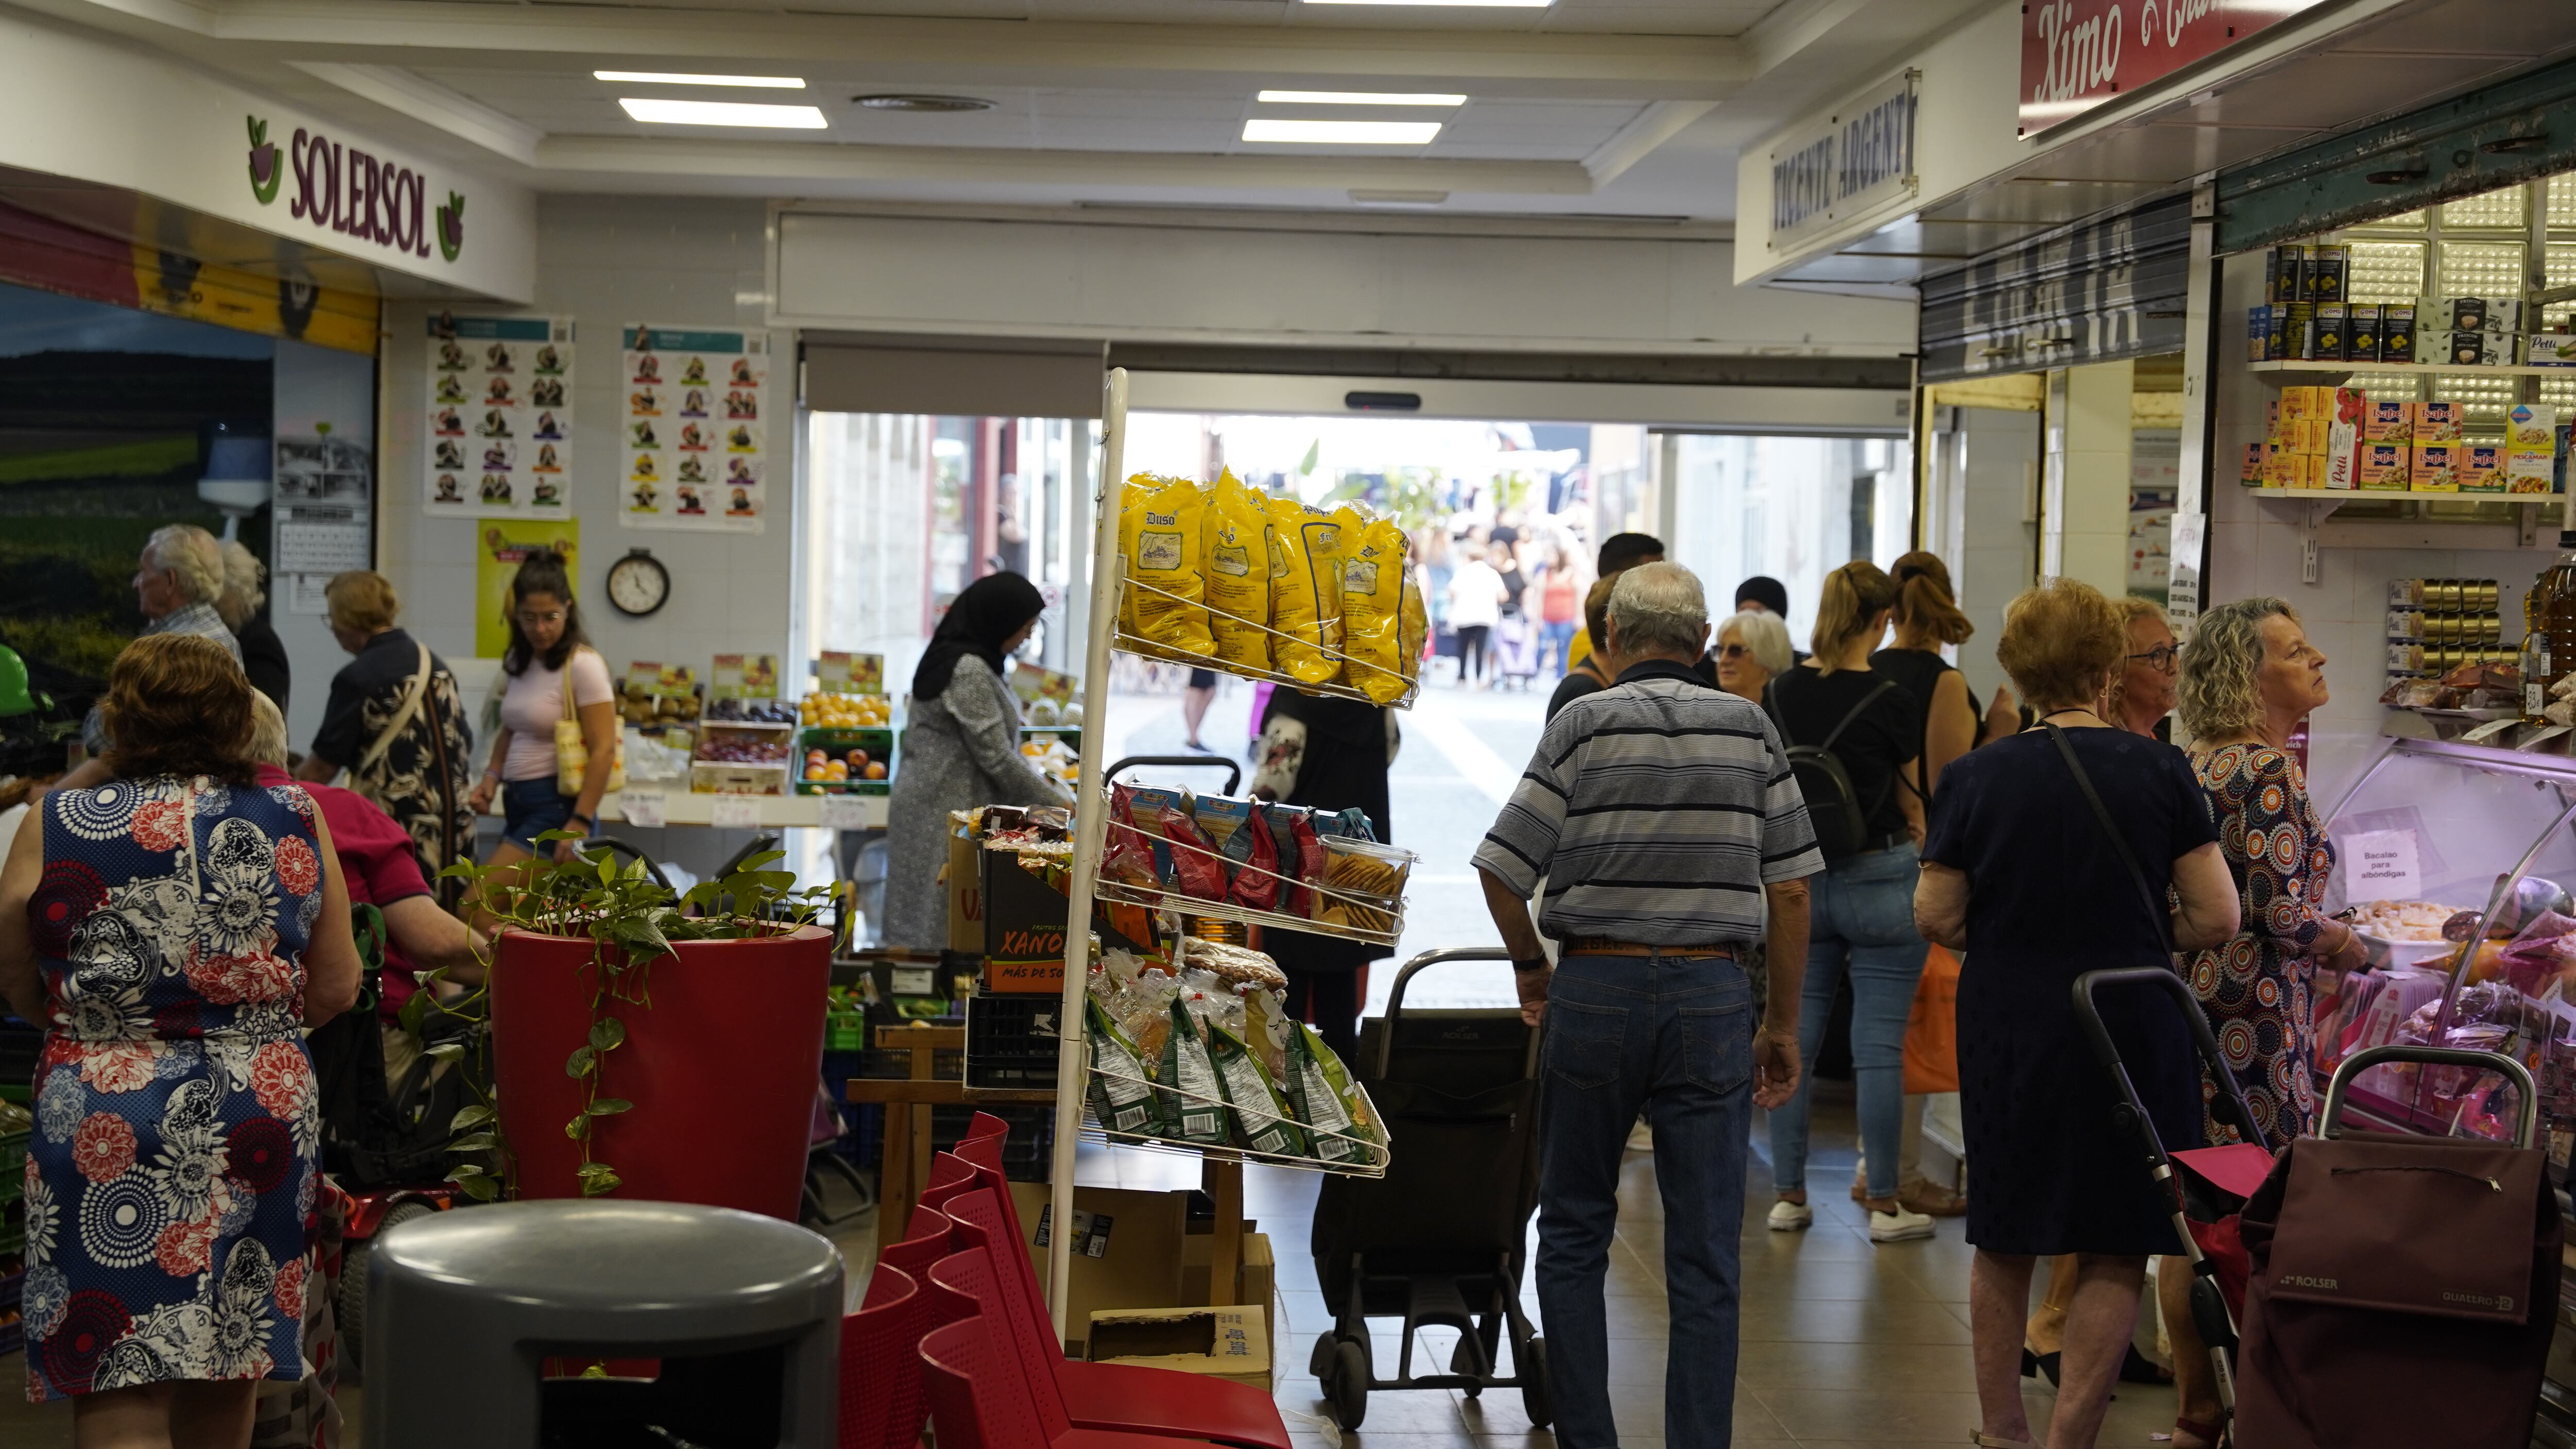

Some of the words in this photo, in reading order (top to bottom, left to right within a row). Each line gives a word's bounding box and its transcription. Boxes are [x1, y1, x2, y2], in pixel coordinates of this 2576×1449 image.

[2035, 0, 2121, 103] Ximo
[1774, 135, 1832, 231] VICENTE
[292, 128, 431, 258] SOLERSOL
[2372, 408, 2406, 420] Isabel
[2421, 409, 2455, 421] Isabel
[2368, 452, 2401, 464] Isabel
[2419, 453, 2453, 465] Isabel
[2467, 454, 2501, 466] Isabel
[1146, 512, 1175, 525] Duso
[2361, 871, 2406, 879] albóndigas
[999, 930, 1064, 956] XANO
[1002, 965, 1027, 978] MÁS
[1031, 968, 1045, 978] DE
[1049, 968, 1063, 978] 50
[2296, 1275, 2338, 1289] ROLSER
